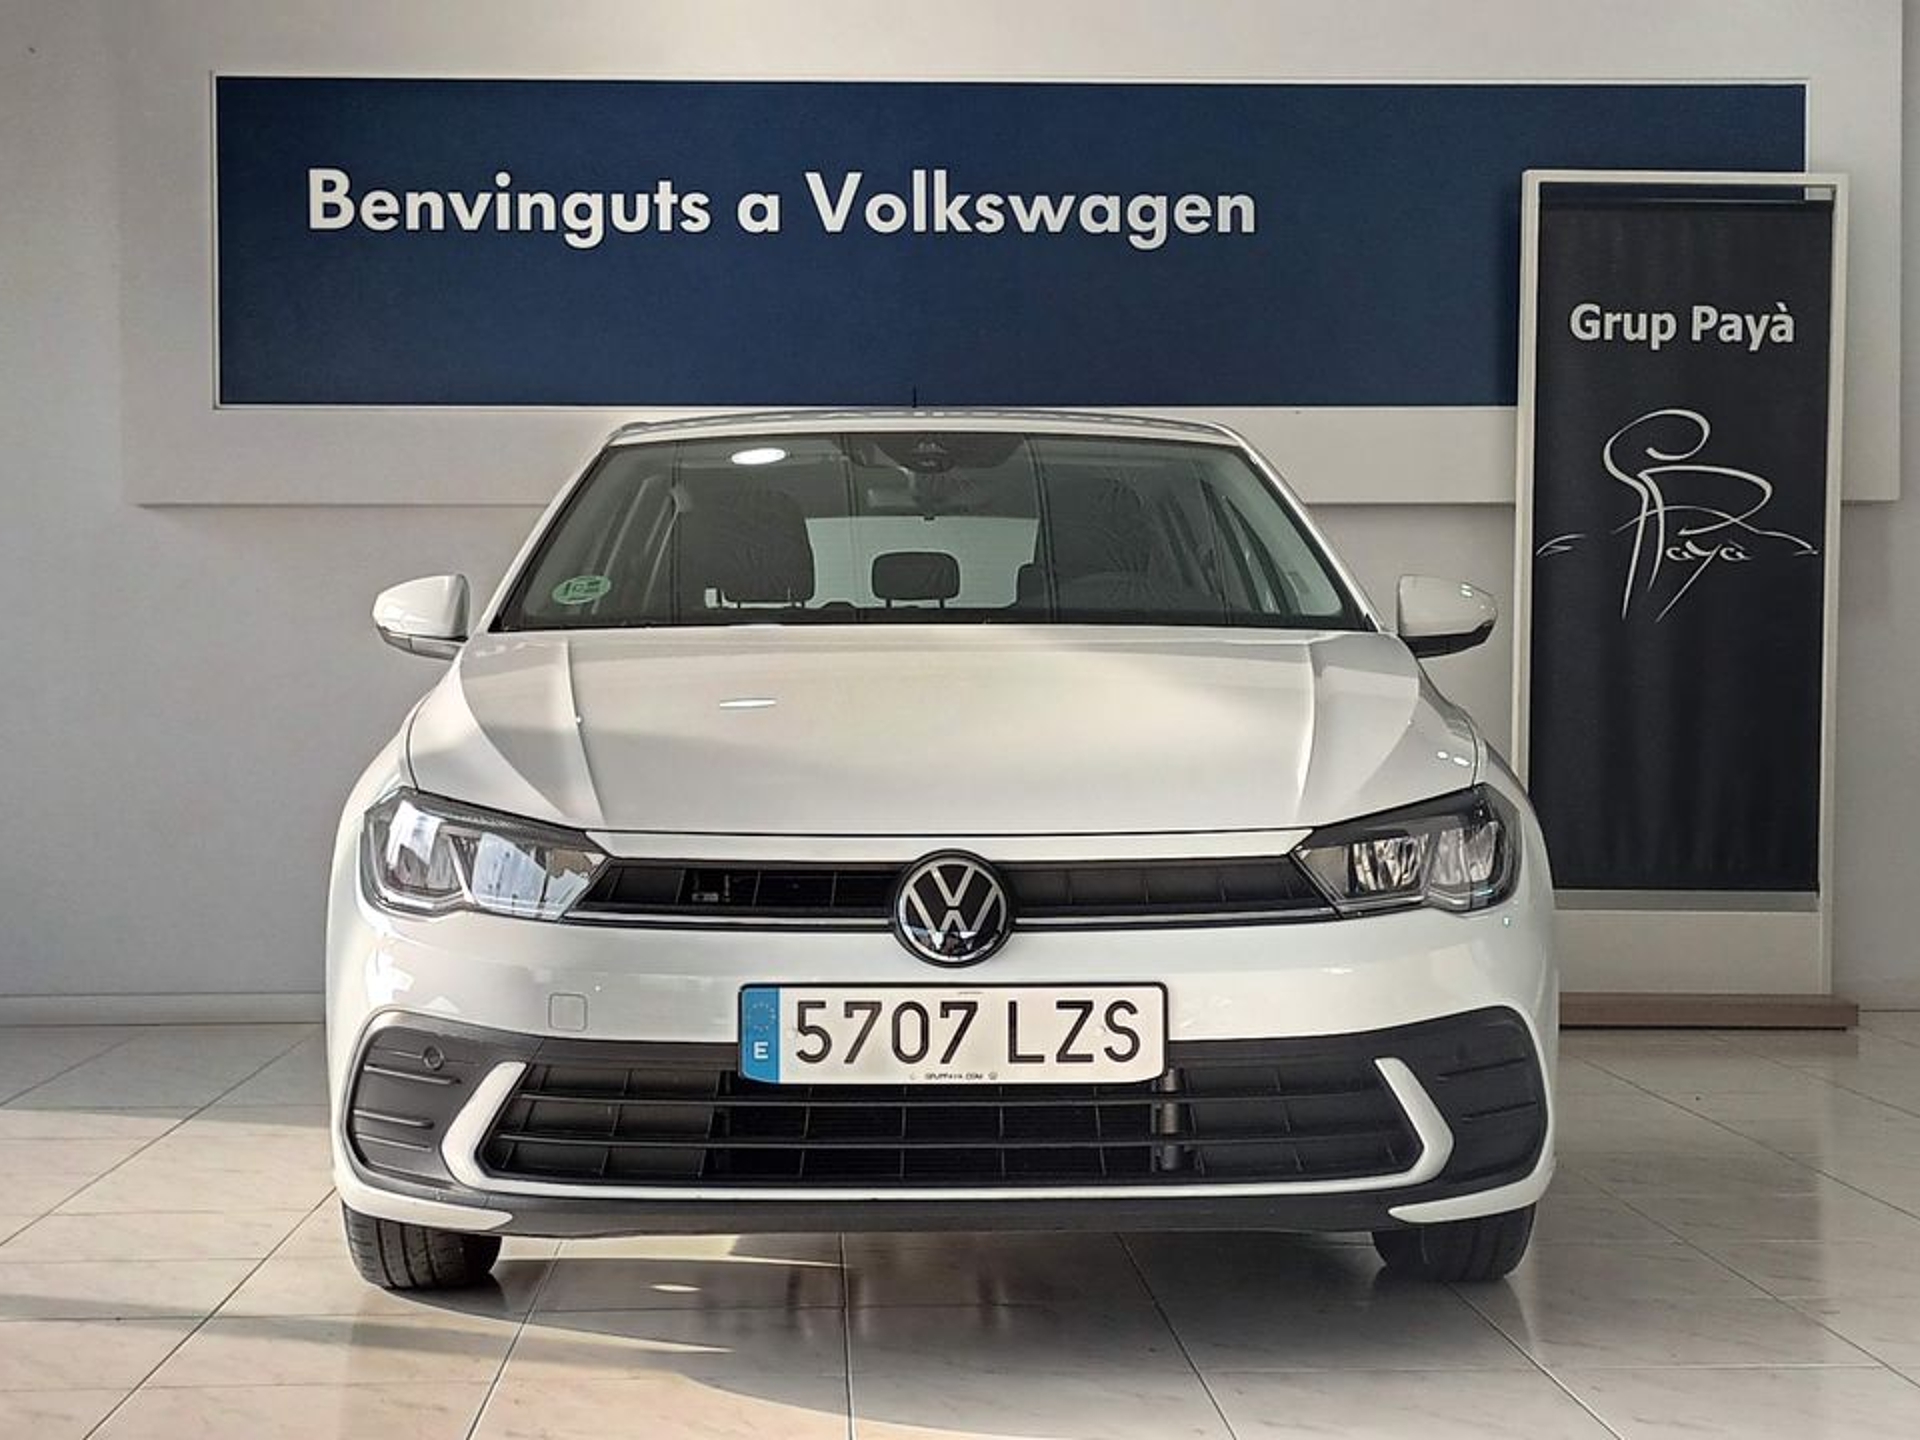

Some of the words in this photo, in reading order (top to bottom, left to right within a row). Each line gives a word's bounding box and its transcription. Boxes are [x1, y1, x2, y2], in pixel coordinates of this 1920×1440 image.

[307, 167, 711, 250] Benvinguts
[736, 192, 781, 233] a
[804, 168, 1257, 251] Volkswagen
[1569, 302, 1678, 351] Grup
[1690, 301, 1796, 352] Payà
[753, 1042, 769, 1060] E
[795, 1000, 979, 1065] 5707
[1007, 999, 1141, 1064] LZS
